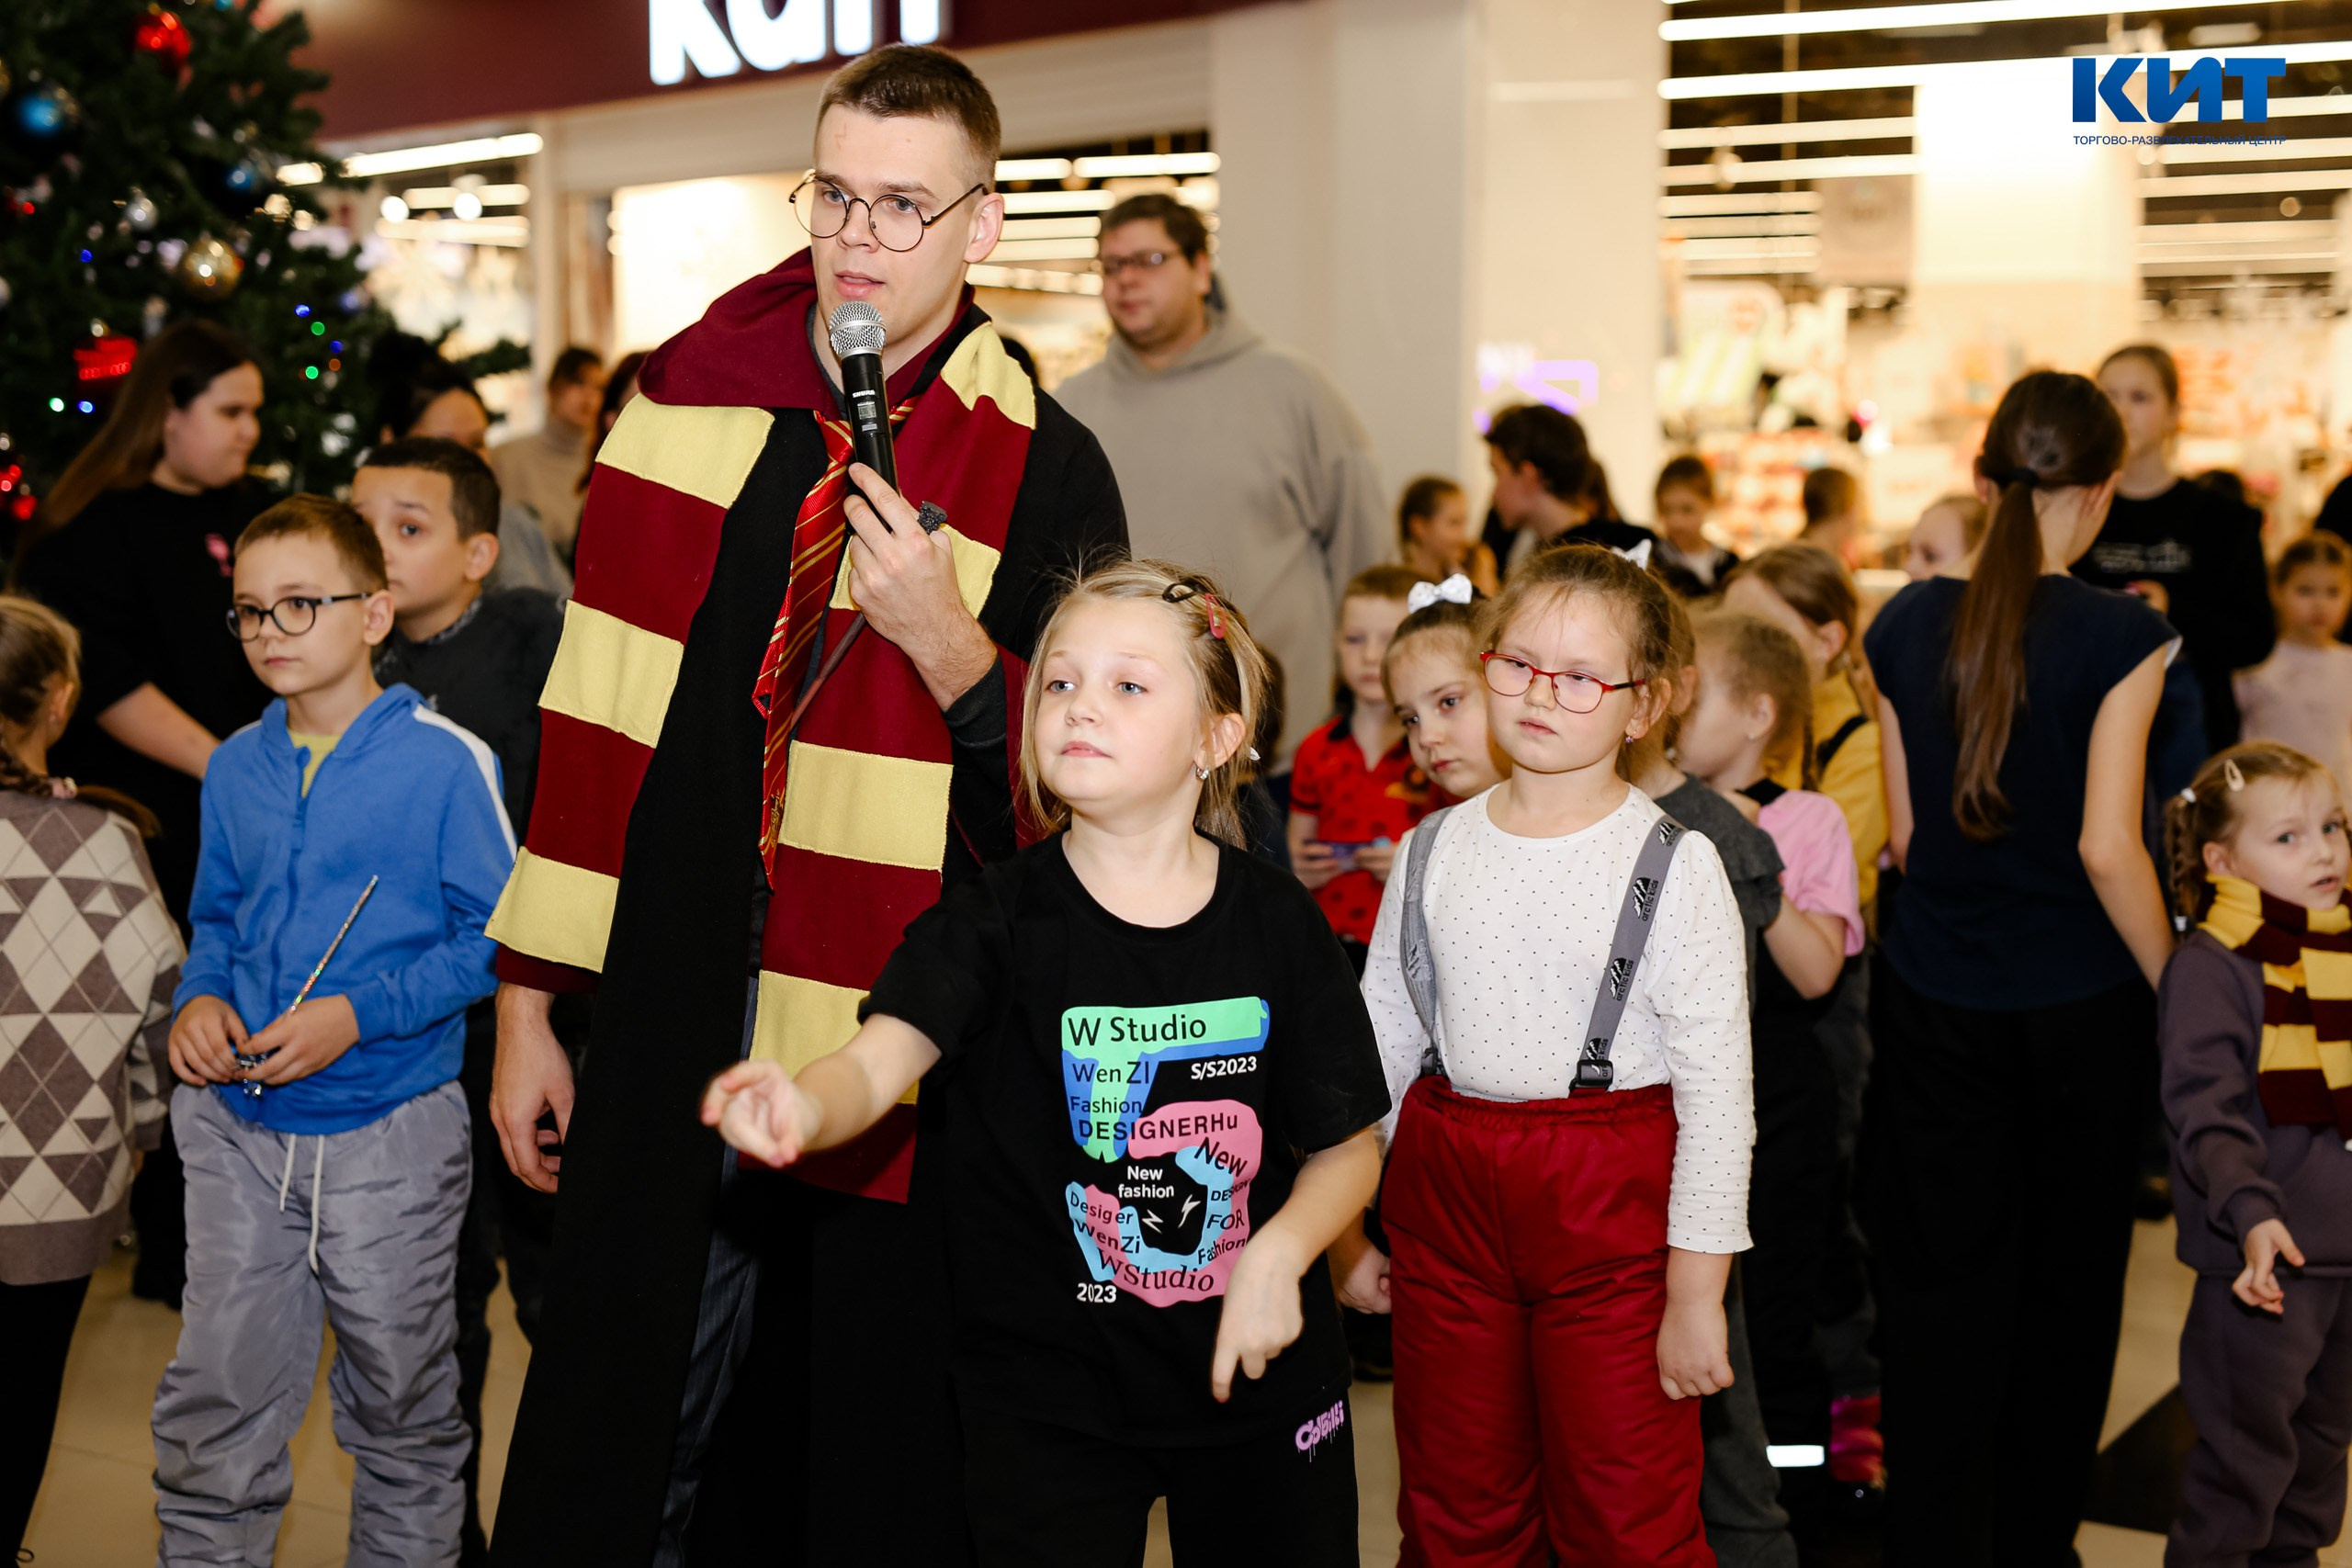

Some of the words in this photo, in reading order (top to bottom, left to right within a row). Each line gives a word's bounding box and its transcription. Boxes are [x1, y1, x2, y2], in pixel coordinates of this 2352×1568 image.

[1068, 1017, 1101, 1046] W
[1110, 1014, 1206, 1042] Studio
[1072, 1063, 1121, 1083] Wen
[1190, 1056, 1258, 1081] S/S2023
[1070, 1096, 1143, 1113] Fashion
[1193, 1136, 1248, 1178] New
[1126, 1165, 1163, 1180] New
[1117, 1183, 1174, 1198] fashion
[1206, 1208, 1245, 1229] FOR
[1075, 1219, 1140, 1254] WenZi
[1197, 1238, 1246, 1265] Fashion
[1077, 1282, 1117, 1303] 2023
